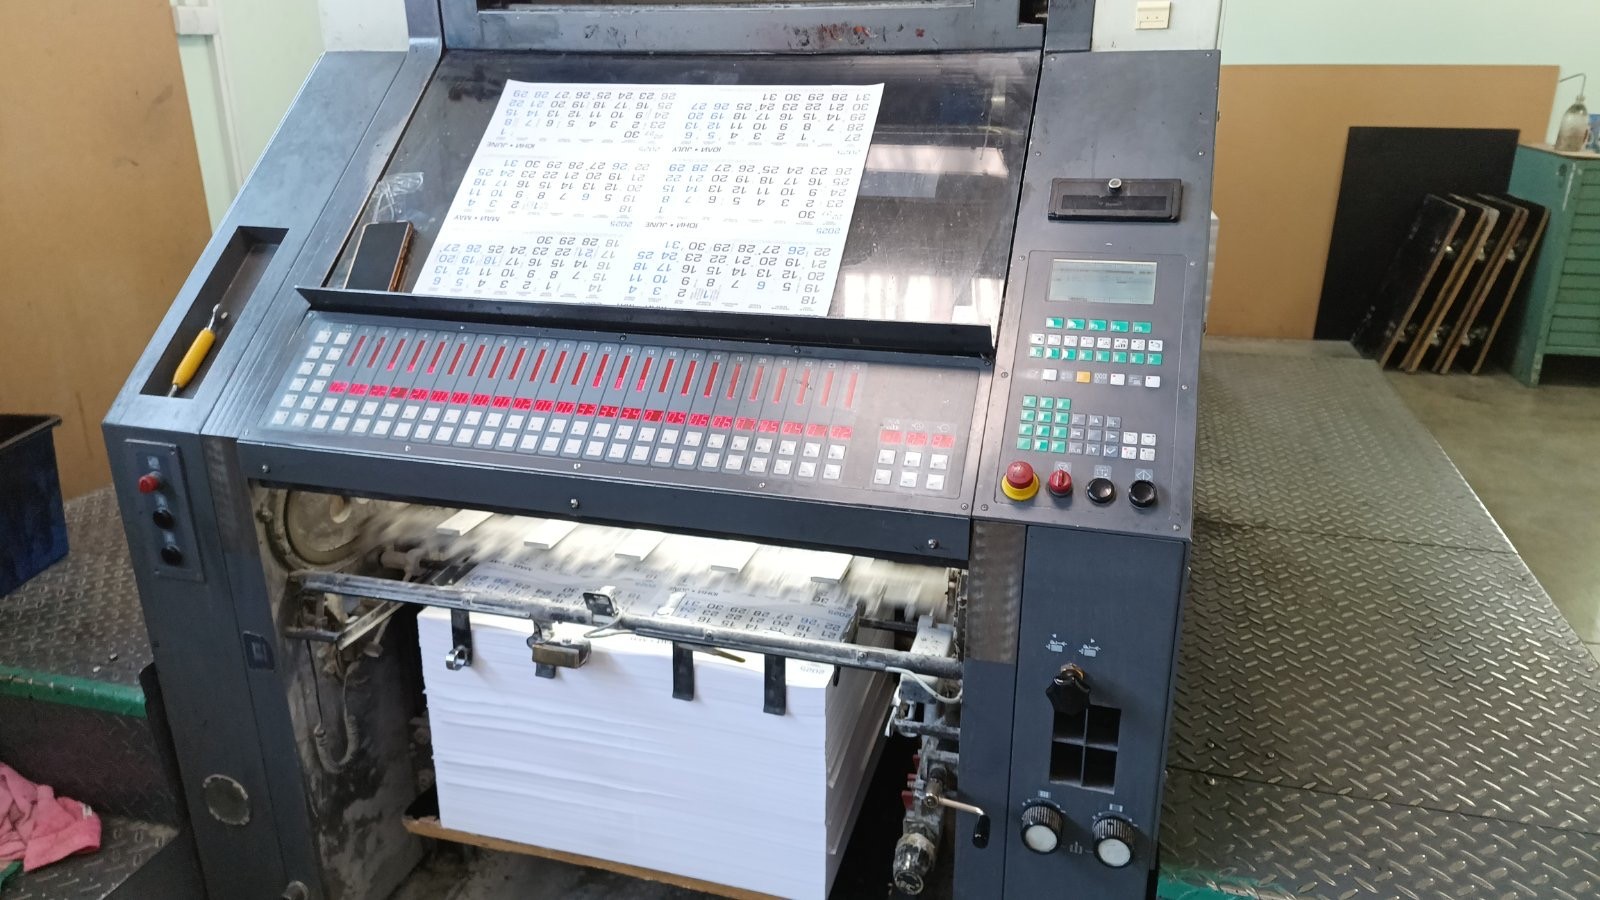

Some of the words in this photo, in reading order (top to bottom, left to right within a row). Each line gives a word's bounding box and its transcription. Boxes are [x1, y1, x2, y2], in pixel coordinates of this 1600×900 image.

[732, 186, 746, 194] 12
[798, 211, 816, 219] 30
[536, 236, 553, 244] 30
[559, 237, 576, 245] 29
[581, 238, 599, 246] 28
[488, 245, 504, 254] 25
[510, 246, 527, 254] 24
[688, 242, 706, 251] 30
[713, 243, 731, 252] 29
[737, 244, 756, 253] 28
[762, 246, 781, 254] 27
[532, 247, 549, 255] 23
[554, 248, 572, 256] 22
[685, 253, 703, 262] 23
[709, 255, 727, 263] 22
[735, 256, 751, 265] 21
[759, 257, 777, 266] 20
[505, 258, 519, 266] 17
[528, 258, 542, 267] 16
[550, 259, 564, 267] 15
[574, 260, 588, 268] 14
[785, 258, 801, 267] 19
[479, 268, 492, 276] 11
[501, 269, 515, 277] 10
[681, 265, 696, 274] 16
[706, 266, 722, 275] 15
[731, 267, 747, 277] 14
[756, 269, 772, 278] 13
[527, 270, 536, 278] 9
[549, 271, 558, 279] 8
[572, 271, 580, 279] 7
[782, 270, 799, 279] 12
[499, 280, 509, 288] 3
[522, 281, 532, 289] 2
[681, 277, 690, 285] 9
[706, 278, 716, 287] 8
[731, 280, 739, 288] 7
[782, 282, 792, 291] 5
[677, 289, 687, 297] 2
[598, 406, 618, 417] 34
[621, 408, 641, 419] 34
